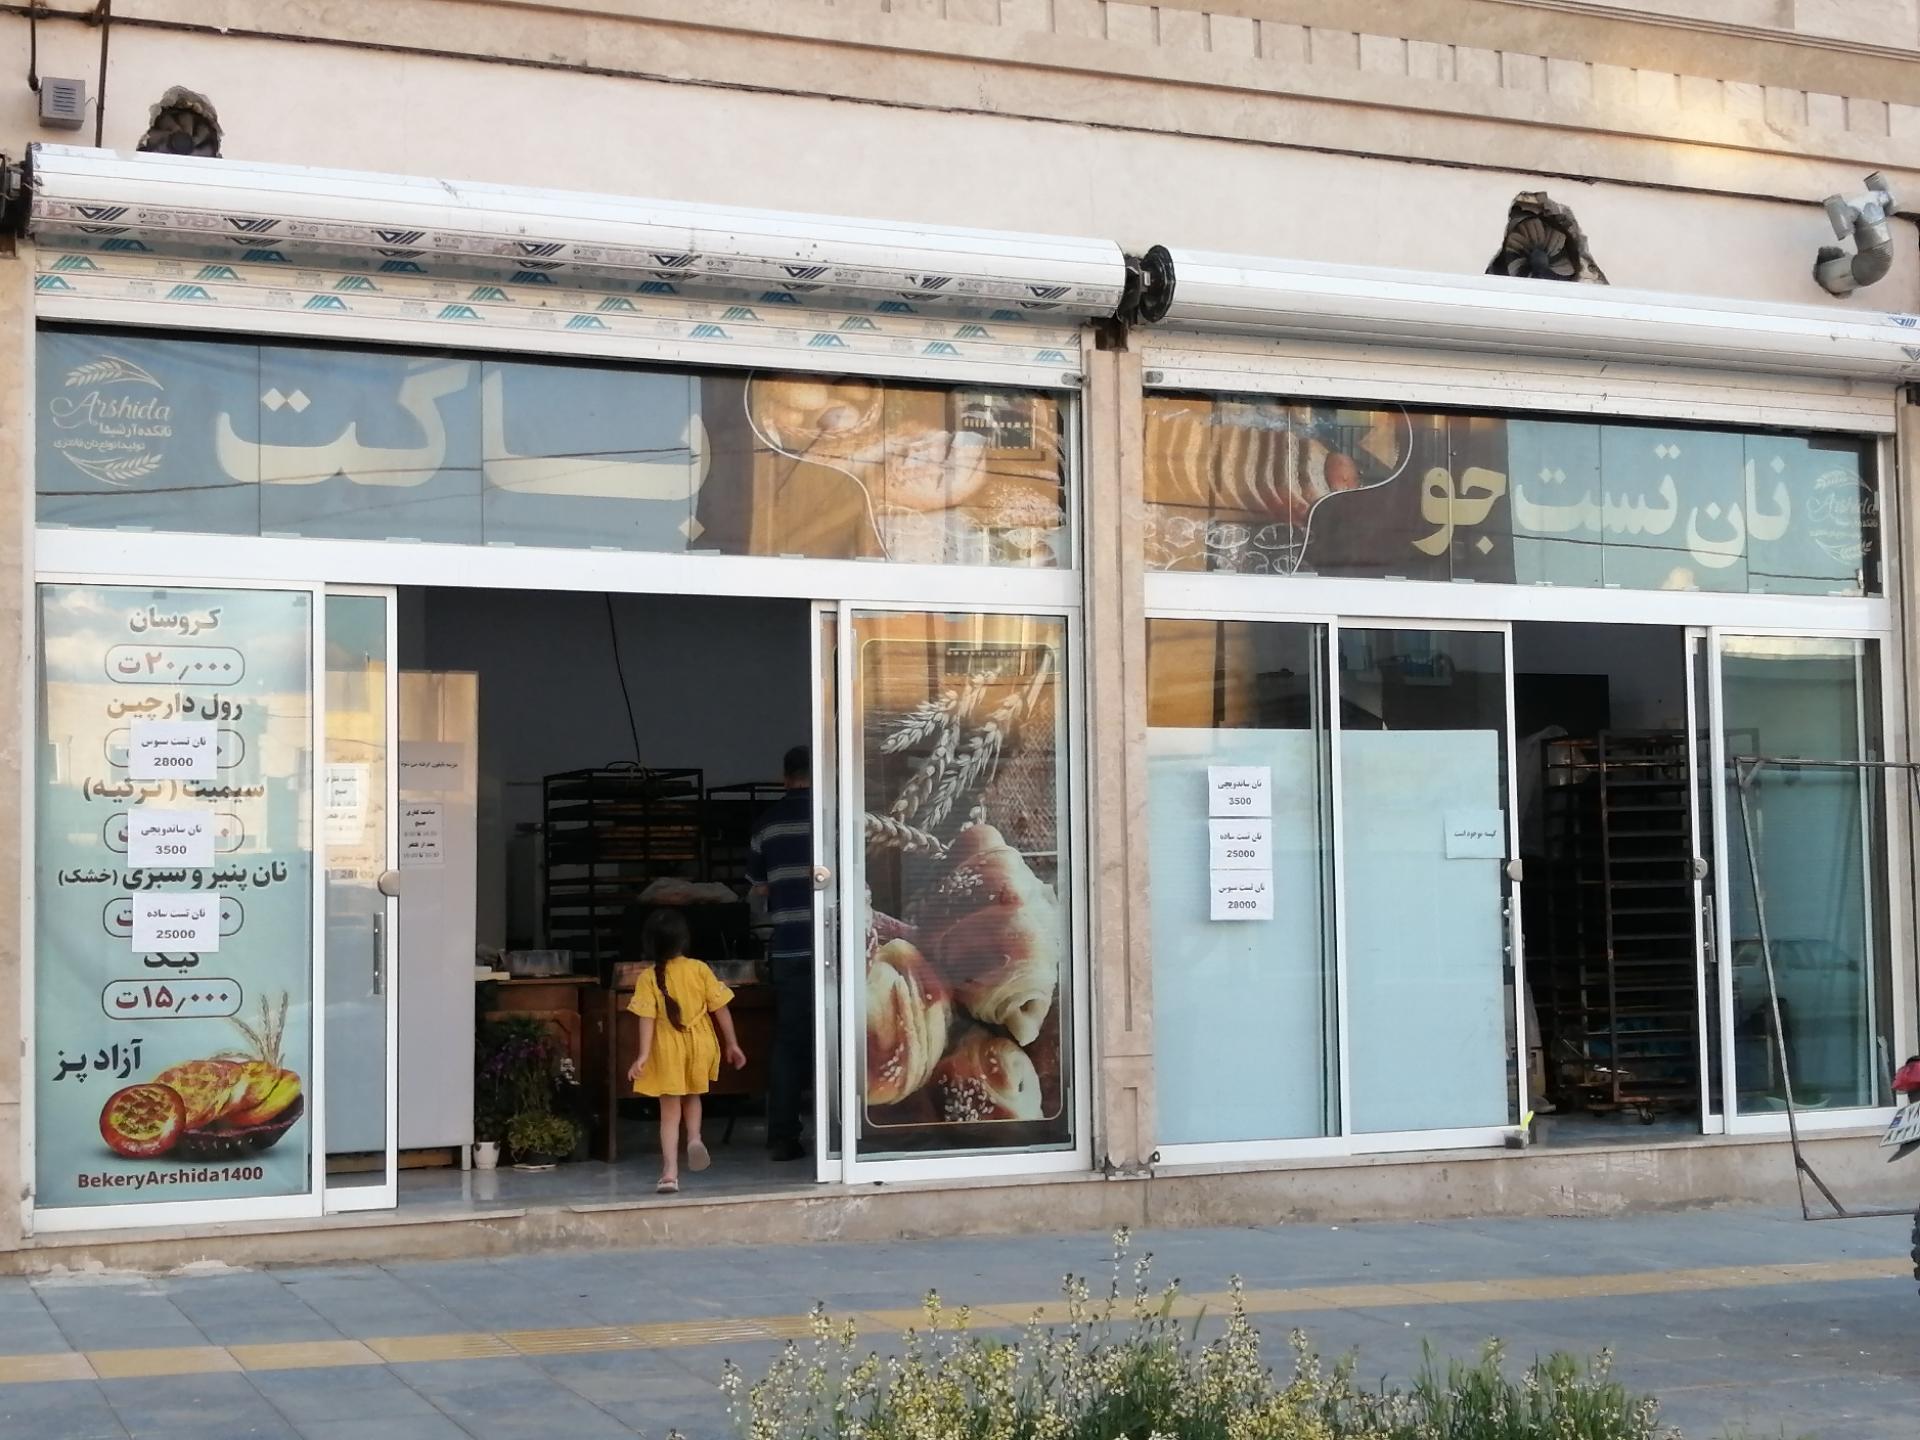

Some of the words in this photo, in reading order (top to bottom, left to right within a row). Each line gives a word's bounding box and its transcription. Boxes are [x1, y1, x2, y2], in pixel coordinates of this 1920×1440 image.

[50, 391, 171, 429] Arshida
[1515, 443, 1679, 535] تست
[1411, 466, 1507, 556] جو
[1687, 455, 1791, 569] نان
[129, 606, 221, 636] کروسان
[107, 692, 196, 721] دارچین
[201, 693, 243, 721] رول
[192, 736, 207, 748] نان
[154, 757, 193, 767] 28000
[183, 778, 265, 804] سیمیت
[1251, 780, 1262, 789] نان
[1229, 797, 1252, 805] 3500
[141, 824, 186, 837] ساندویچی
[188, 824, 202, 836] نان
[1252, 832, 1262, 842] نان
[155, 845, 187, 855] 3500
[1226, 849, 1255, 858] 25000
[58, 869, 118, 887] (خشک)
[122, 868, 187, 890] سبزی
[191, 871, 203, 889] و
[206, 864, 248, 891] پنیر
[252, 861, 288, 887] نان
[1255, 883, 1265, 893] نان
[147, 909, 167, 918] ساده
[170, 909, 190, 918] تست
[1227, 900, 1257, 909] 28000
[191, 908, 206, 920] نان
[156, 930, 196, 939] 25000
[52, 1050, 87, 1083] پز
[94, 1038, 143, 1079] آزاد
[78, 1166, 263, 1190] BekeryArshida1400
